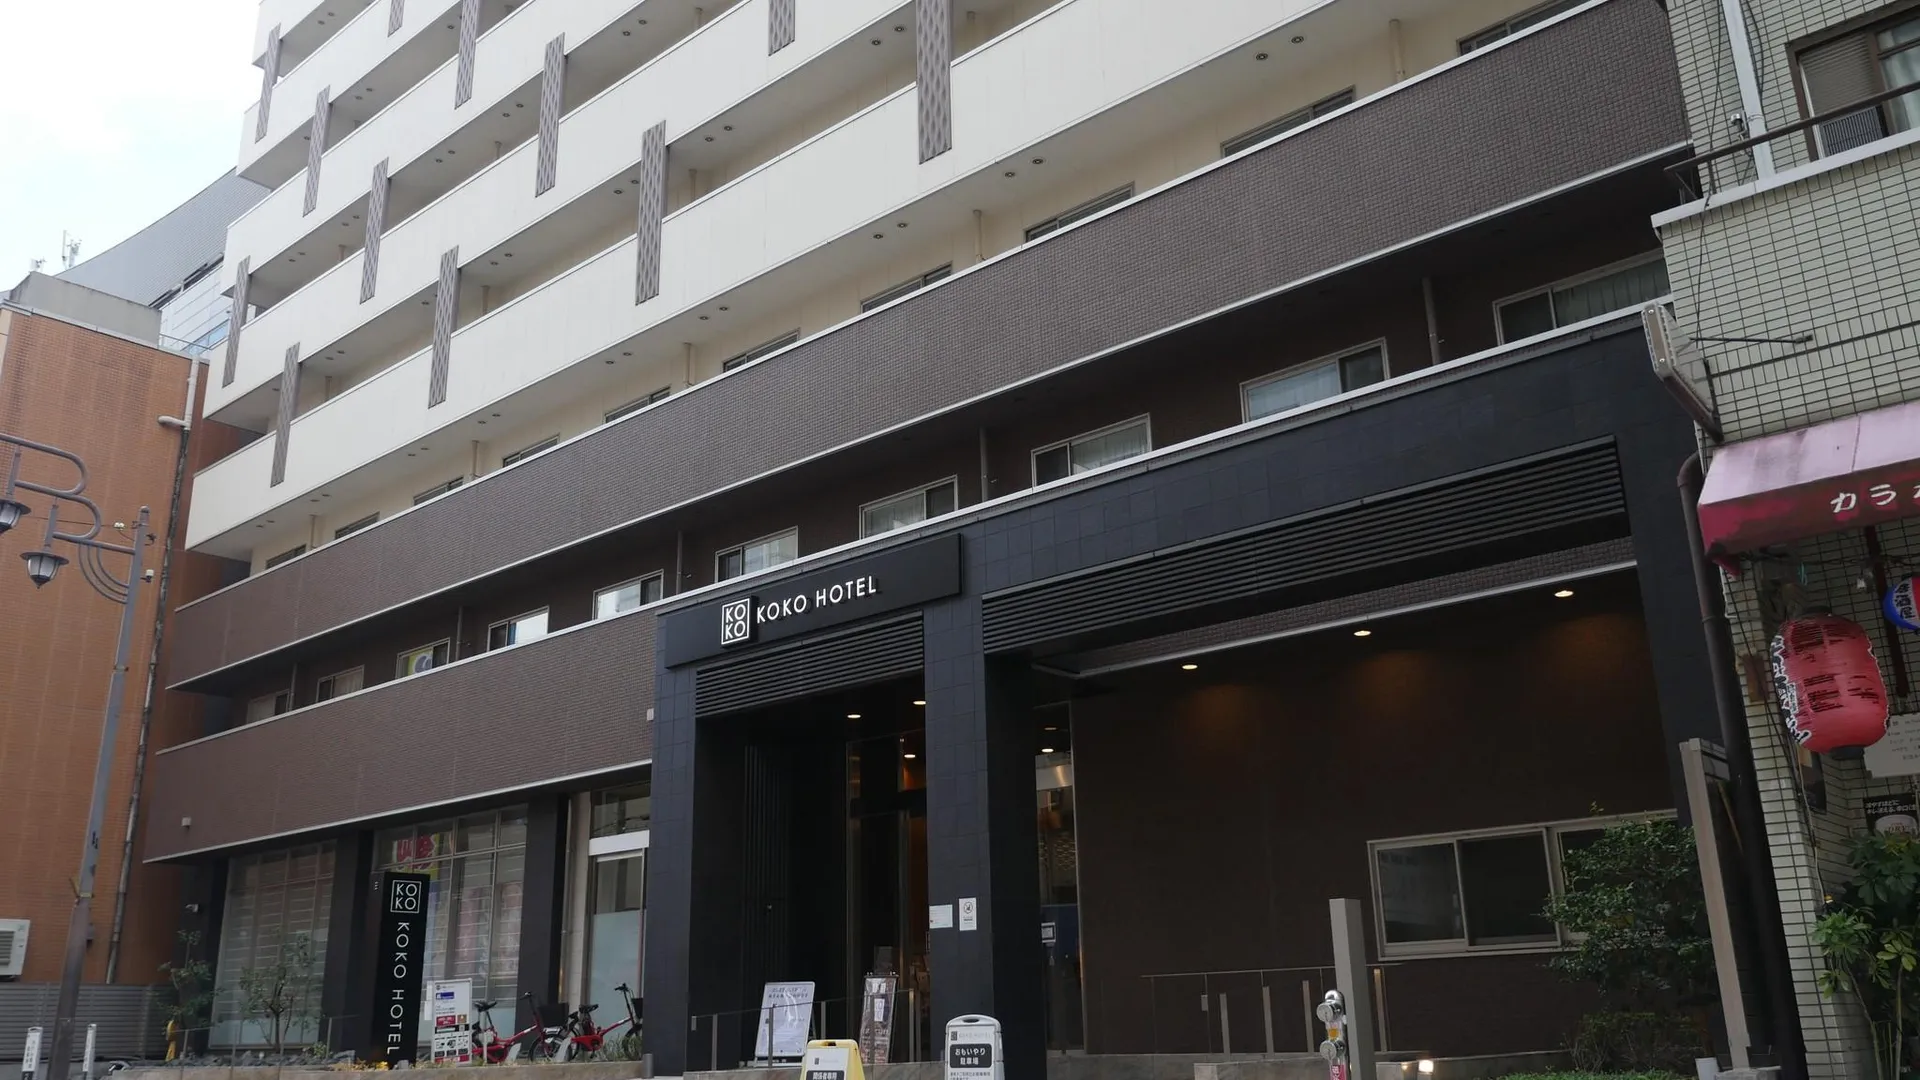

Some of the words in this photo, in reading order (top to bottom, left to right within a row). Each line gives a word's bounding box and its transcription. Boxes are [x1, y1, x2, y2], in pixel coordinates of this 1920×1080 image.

[756, 594, 807, 624] KOKO
[815, 575, 877, 608] HOTEL
[725, 604, 746, 624] KO
[725, 620, 746, 641] KO
[395, 883, 418, 897] KO
[394, 897, 417, 911] KO
[393, 921, 410, 979] KOKO
[386, 989, 405, 1055] HOTEL
[955, 1047, 986, 1056] おもいやり
